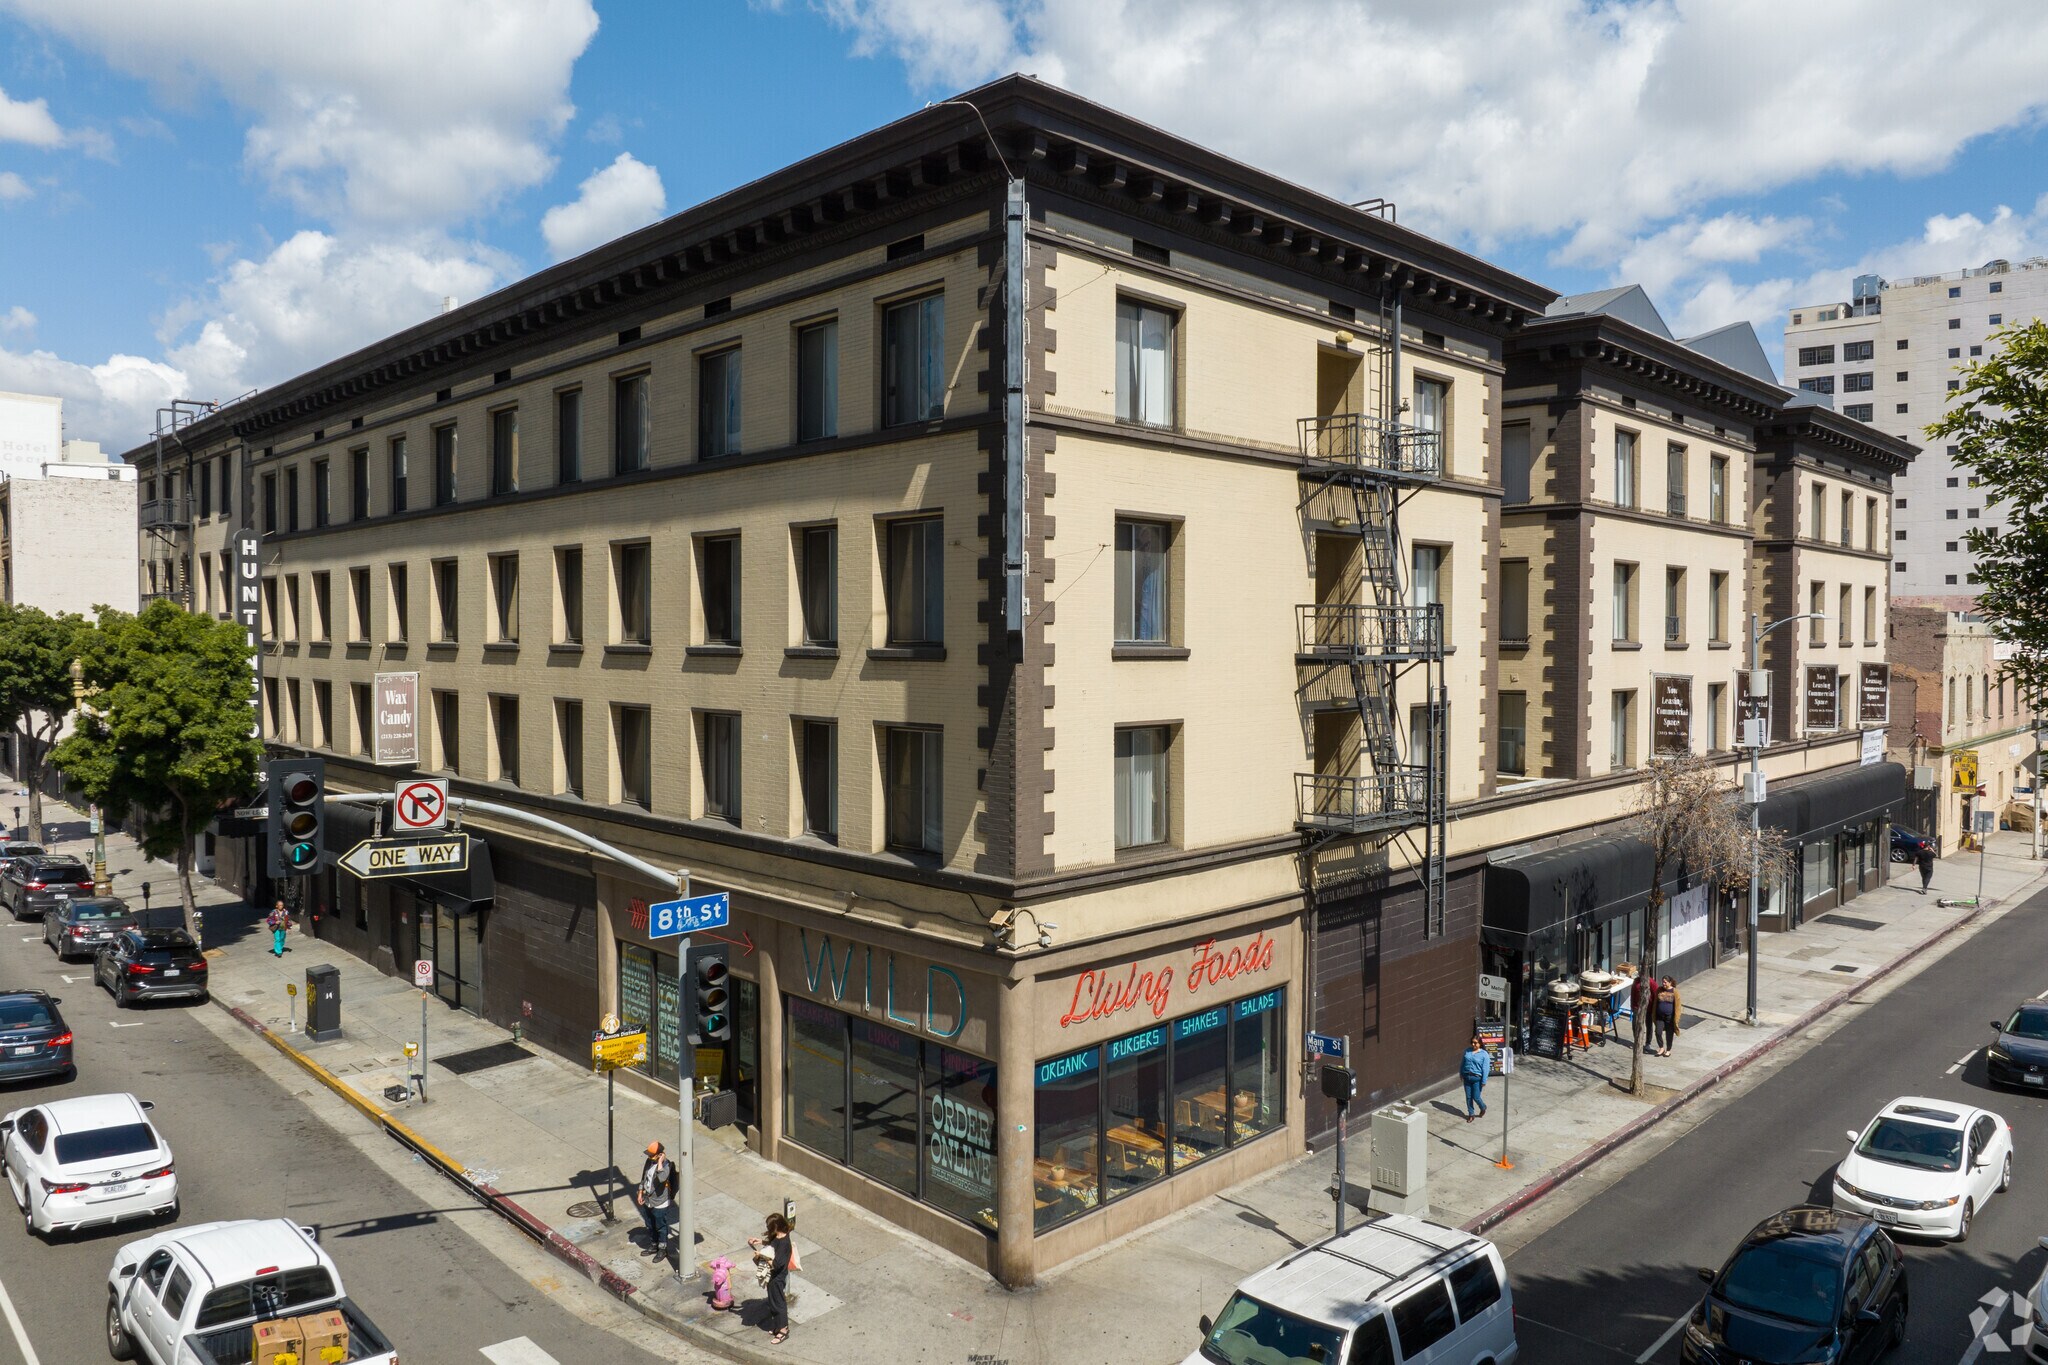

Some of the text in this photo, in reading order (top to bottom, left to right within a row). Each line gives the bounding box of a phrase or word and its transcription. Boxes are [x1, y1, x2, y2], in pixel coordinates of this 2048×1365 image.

[385, 690, 407, 705] Wax
[381, 710, 412, 728] Candy
[369, 845, 456, 867] ONE WAY
[658, 905, 692, 930] 8th
[701, 902, 721, 922] St
[800, 927, 966, 1038] WILD
[1060, 928, 1276, 1028] Living Foods
[1112, 1030, 1160, 1058] BURGERS
[1182, 1010, 1219, 1036] SHAKES
[1241, 993, 1274, 1017] SALADS
[1307, 1035, 1341, 1050] Main St
[931, 1094, 991, 1150] ORDER
[930, 1131, 992, 1186] ONLINE
